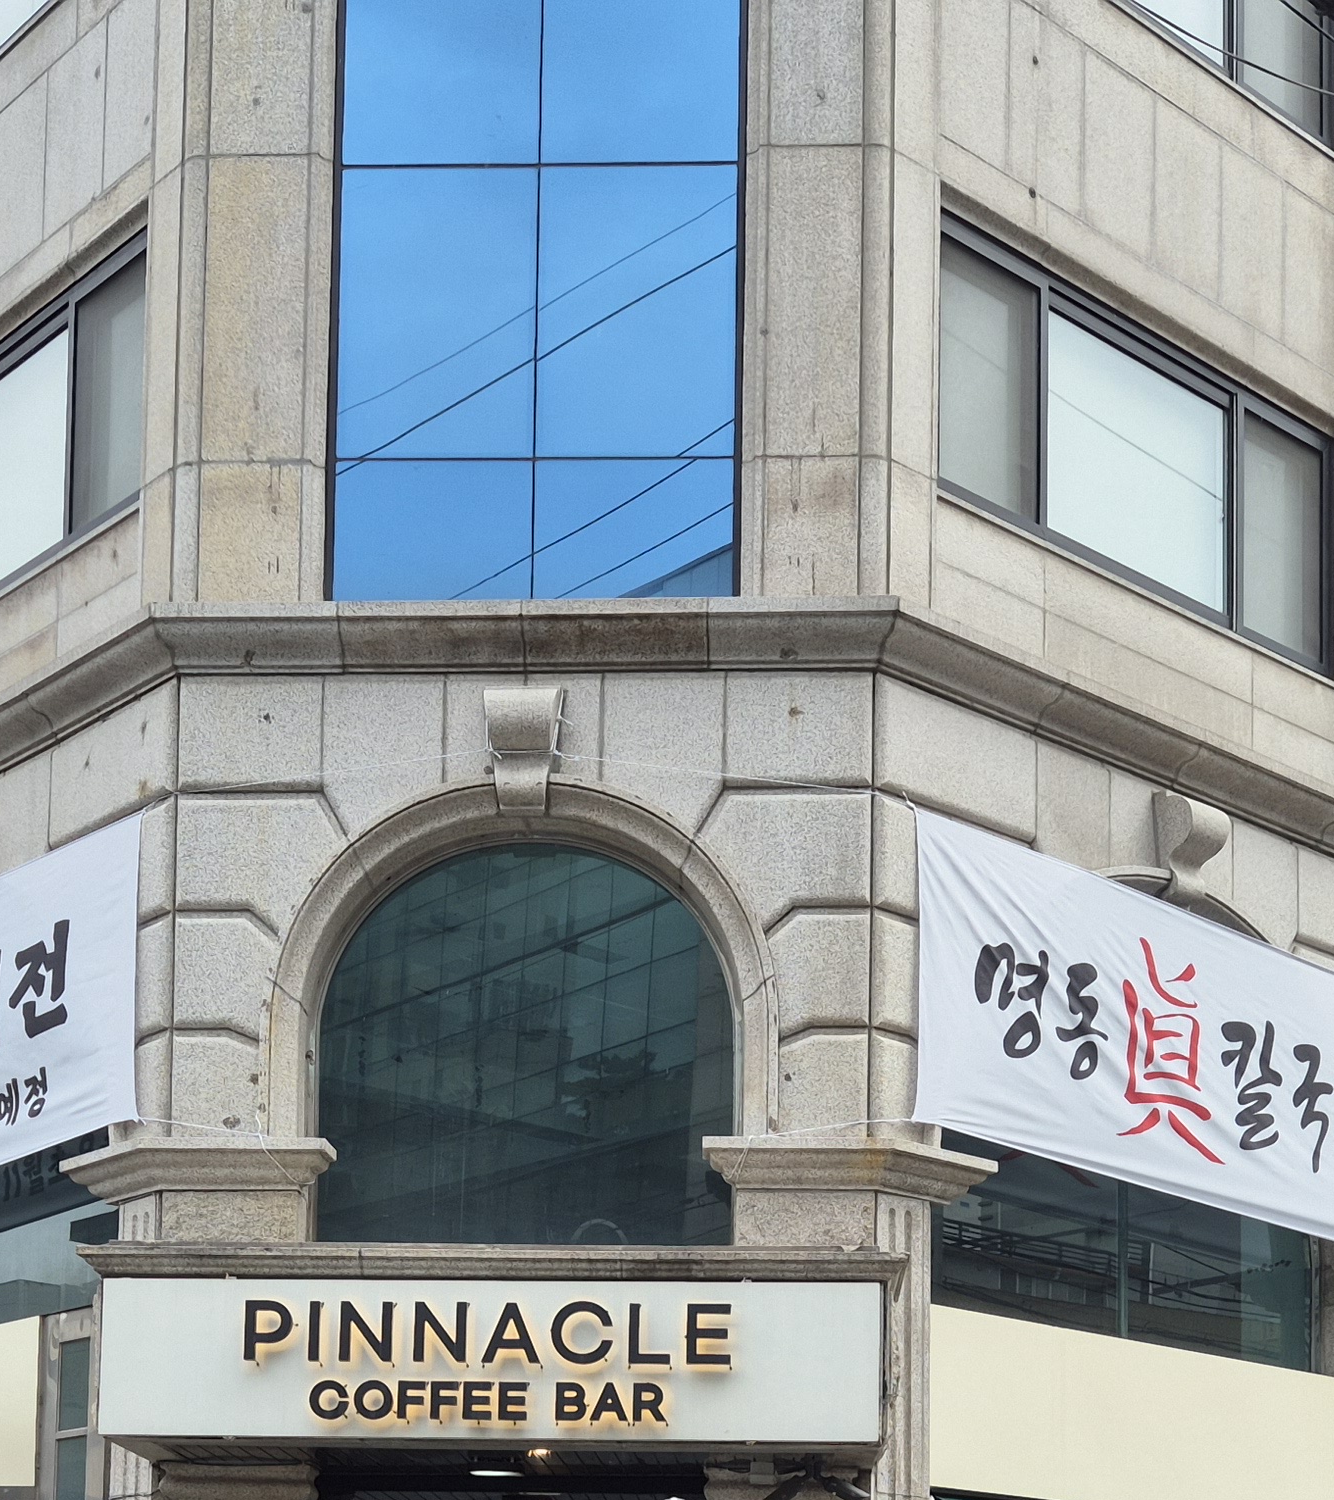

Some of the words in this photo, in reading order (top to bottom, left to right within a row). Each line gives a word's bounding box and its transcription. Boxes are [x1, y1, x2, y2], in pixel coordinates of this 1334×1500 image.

[242, 1299, 732, 1367] PINNACLE
[309, 1379, 528, 1423] COFFEE
[555, 1381, 668, 1424] BAR
